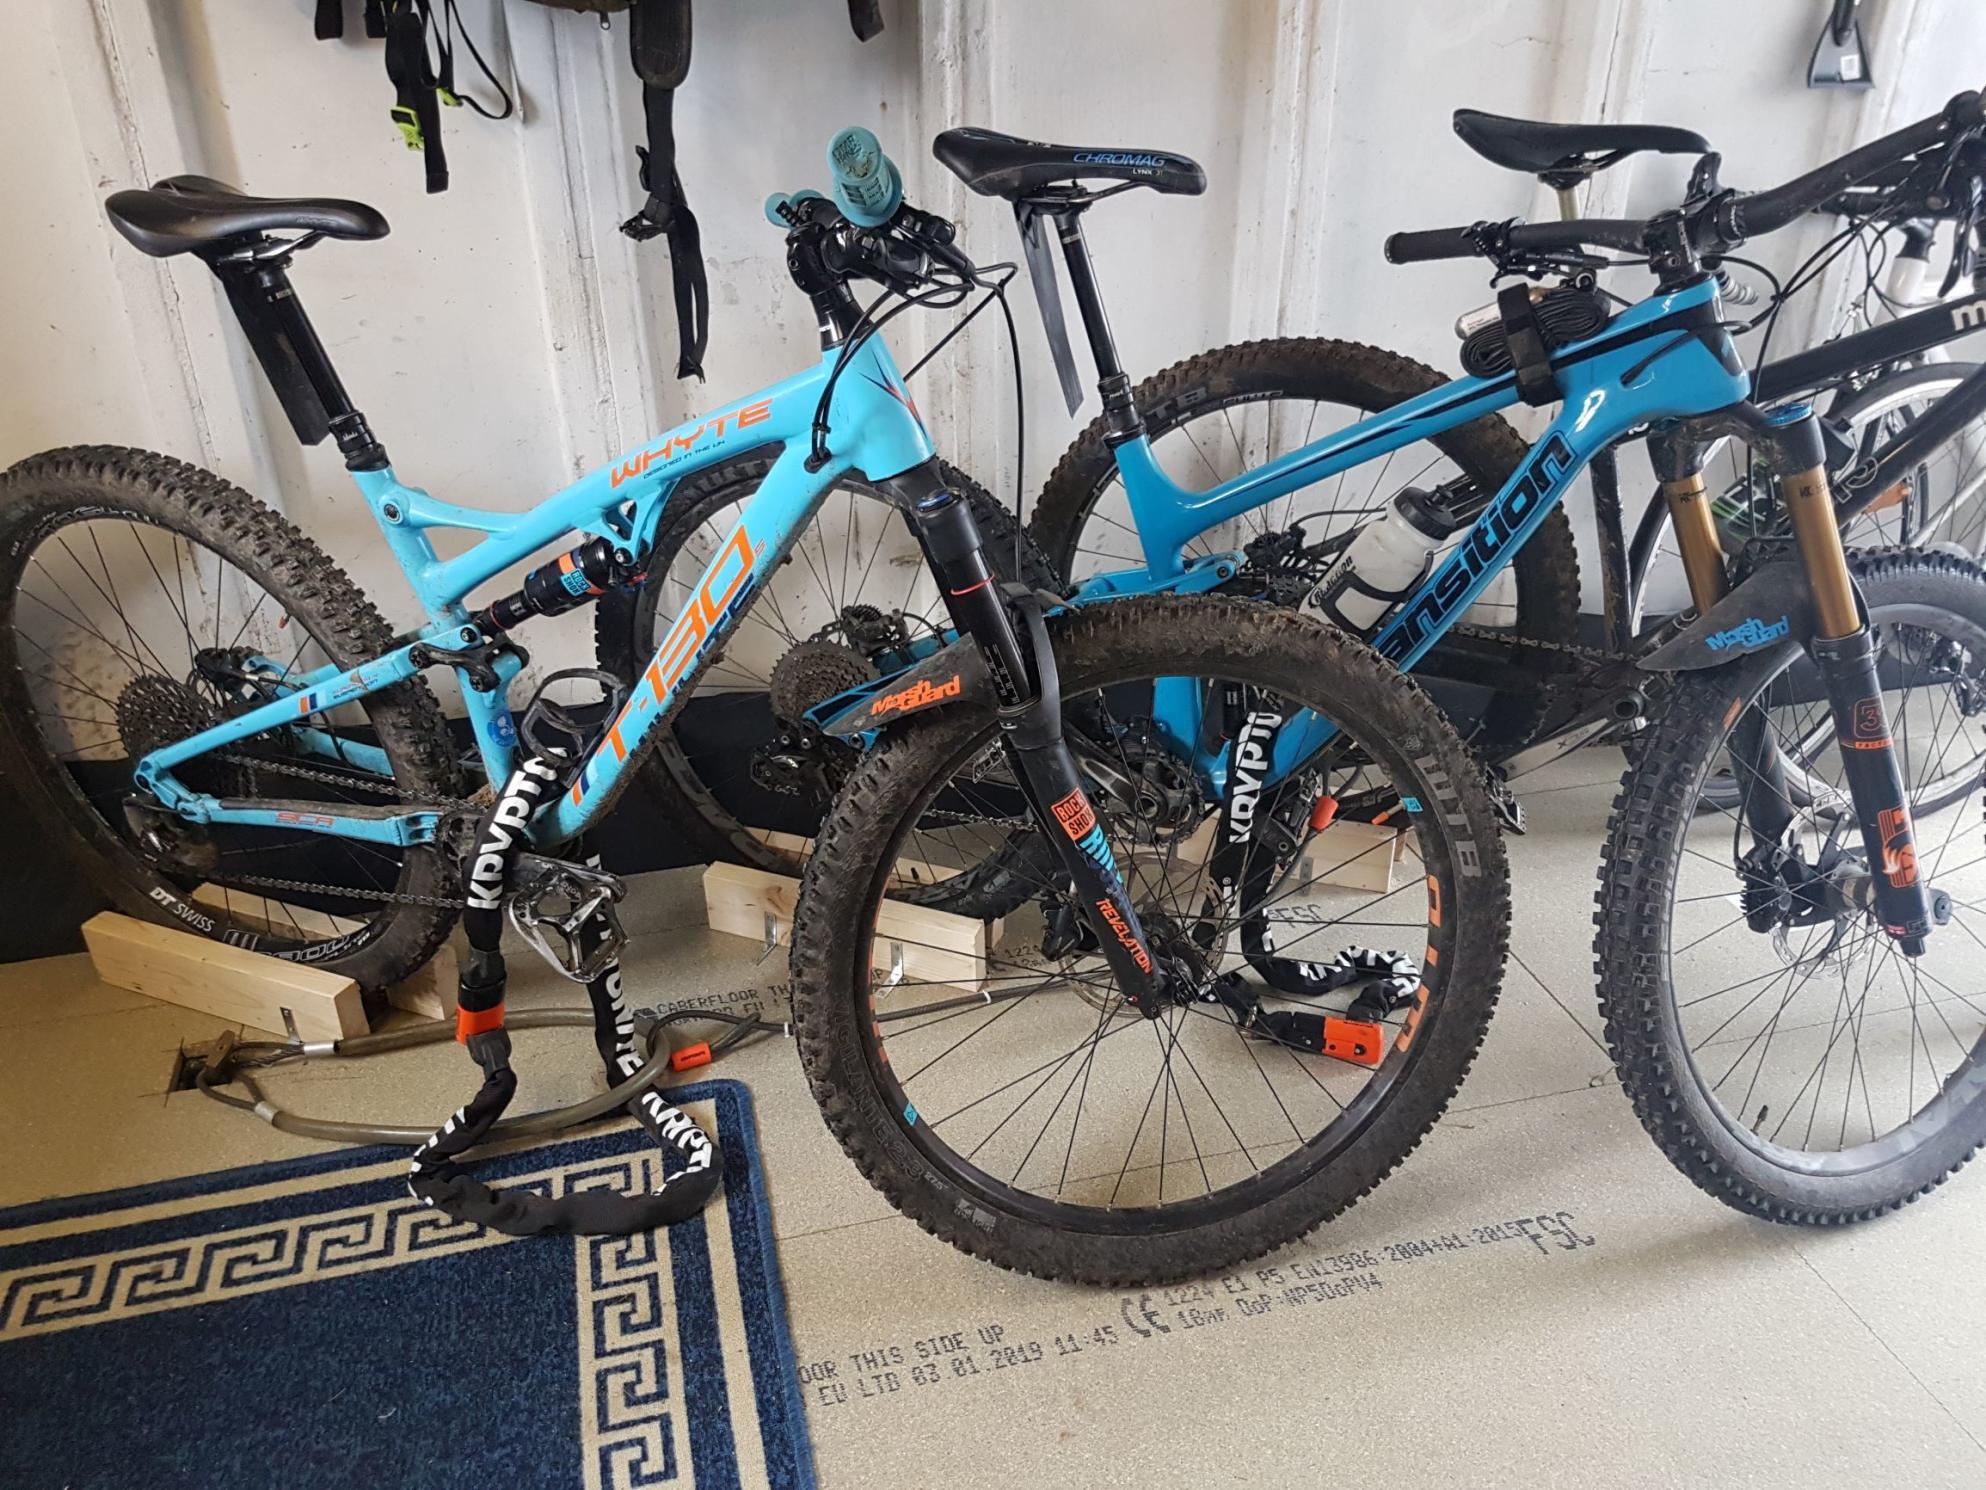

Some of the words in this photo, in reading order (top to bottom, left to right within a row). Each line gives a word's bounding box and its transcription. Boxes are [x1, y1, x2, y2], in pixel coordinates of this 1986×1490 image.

[1073, 152, 1166, 167] CHROMAG
[611, 399, 774, 488] WHYTE
[1376, 432, 1577, 660] ansition
[570, 569, 592, 591] ROCK
[598, 525, 756, 762] T-130
[1056, 793, 1086, 823] ROCK
[1068, 810, 1095, 835] SHOX
[149, 887, 176, 907] DT
[174, 902, 215, 933] SWISS
[1096, 898, 1153, 974] REVELATION
[656, 988, 760, 1016] CABERFLOOR
[767, 983, 792, 998] TH
[1514, 1211, 1597, 1255] FSC
[1255, 1267, 1287, 1287] P5
[850, 1346, 905, 1374] THIS
[914, 1332, 971, 1360] SIDE
[977, 1324, 1004, 1346] UP
[857, 1371, 902, 1399] LTD
[1054, 1324, 1120, 1357] 11:45
